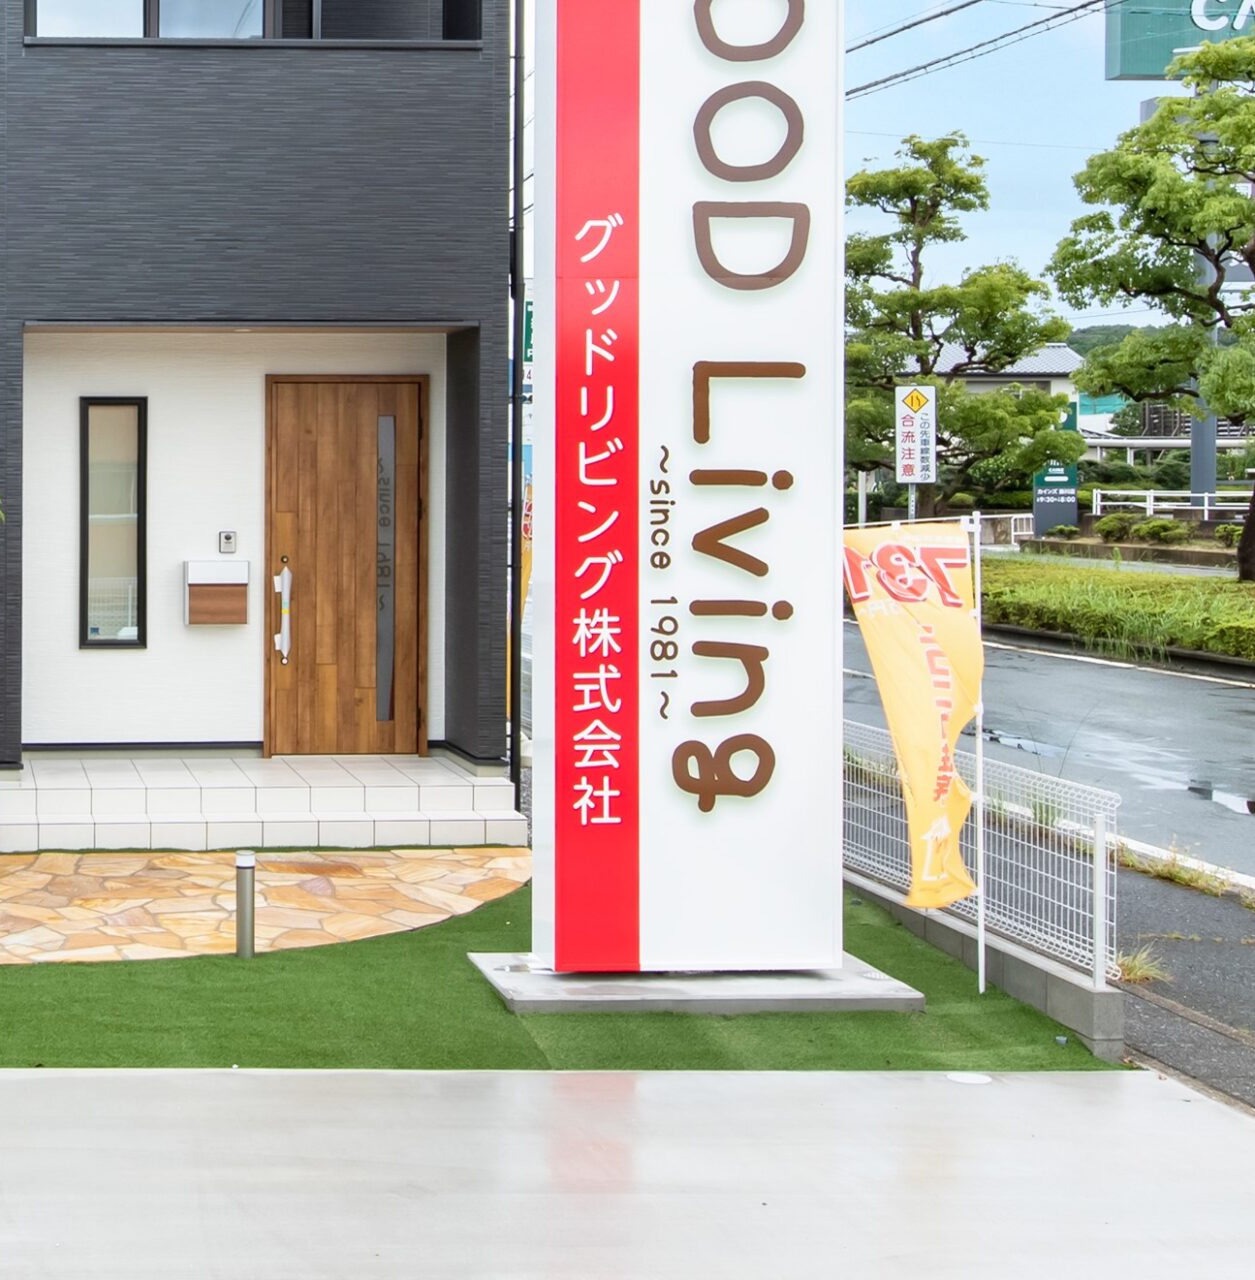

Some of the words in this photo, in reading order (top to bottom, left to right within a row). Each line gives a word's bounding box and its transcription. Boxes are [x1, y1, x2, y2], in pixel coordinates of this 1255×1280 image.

[572, 212, 624, 825] グッドリビング株式会社
[671, 360, 807, 813] Living
[900, 414, 916, 477] 合流注意
